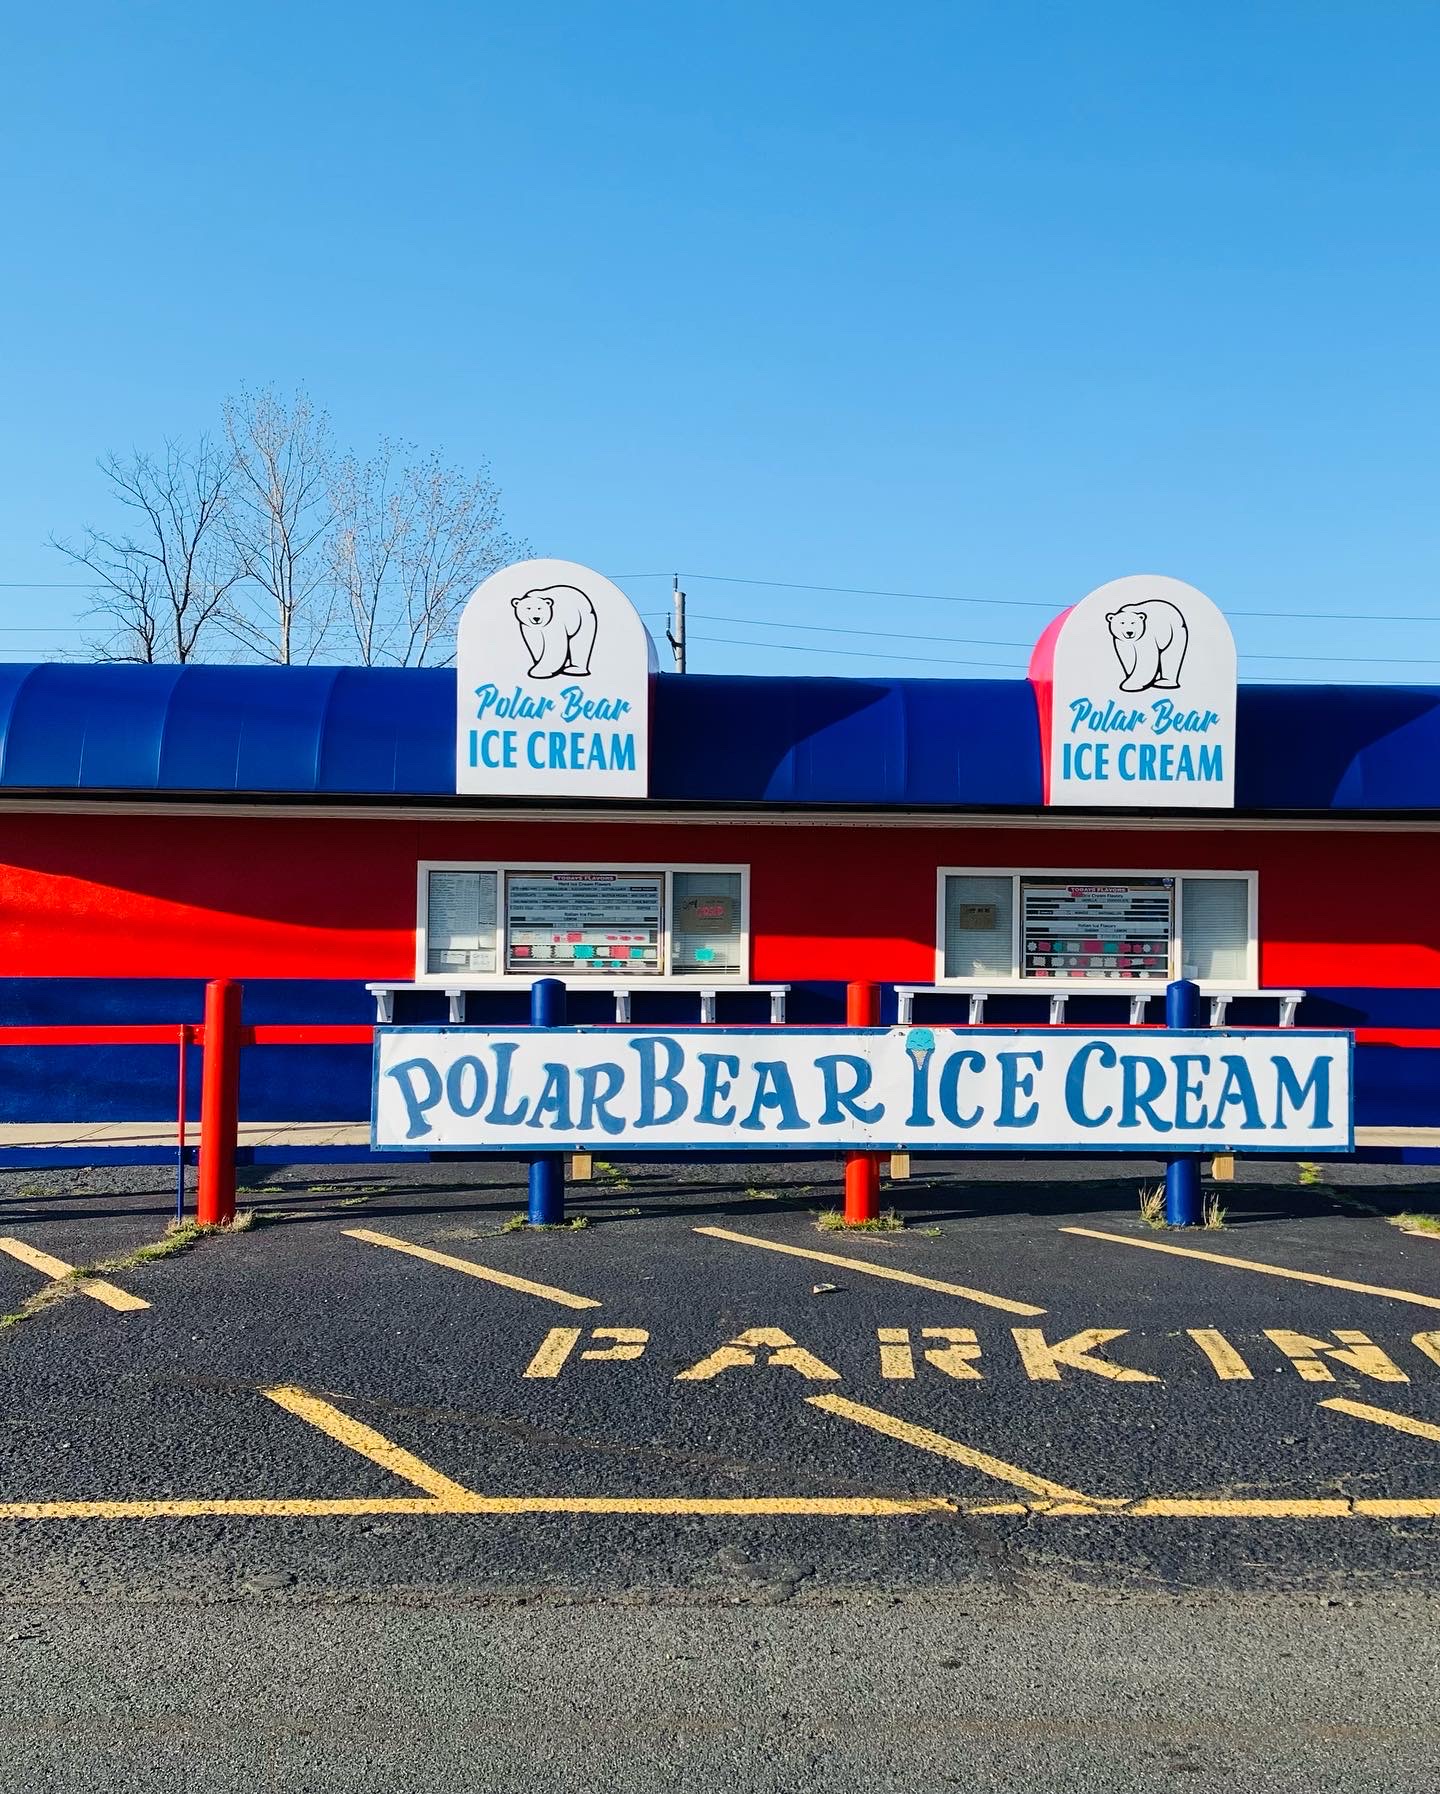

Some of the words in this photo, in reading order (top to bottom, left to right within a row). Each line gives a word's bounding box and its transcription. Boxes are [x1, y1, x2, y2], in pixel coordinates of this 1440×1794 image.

[474, 683, 556, 720] Polar
[560, 685, 632, 723] Bear
[1069, 697, 1147, 733] Polar
[1151, 698, 1221, 735] Bear
[469, 729, 518, 769] ICE
[527, 731, 636, 771] CREAM
[1063, 742, 1109, 781] ICE
[1117, 743, 1224, 782] CREAM
[905, 1028, 1044, 1129] ICE
[1064, 1041, 1335, 1133] CREAM
[522, 1327, 1440, 1382] PARKIN
